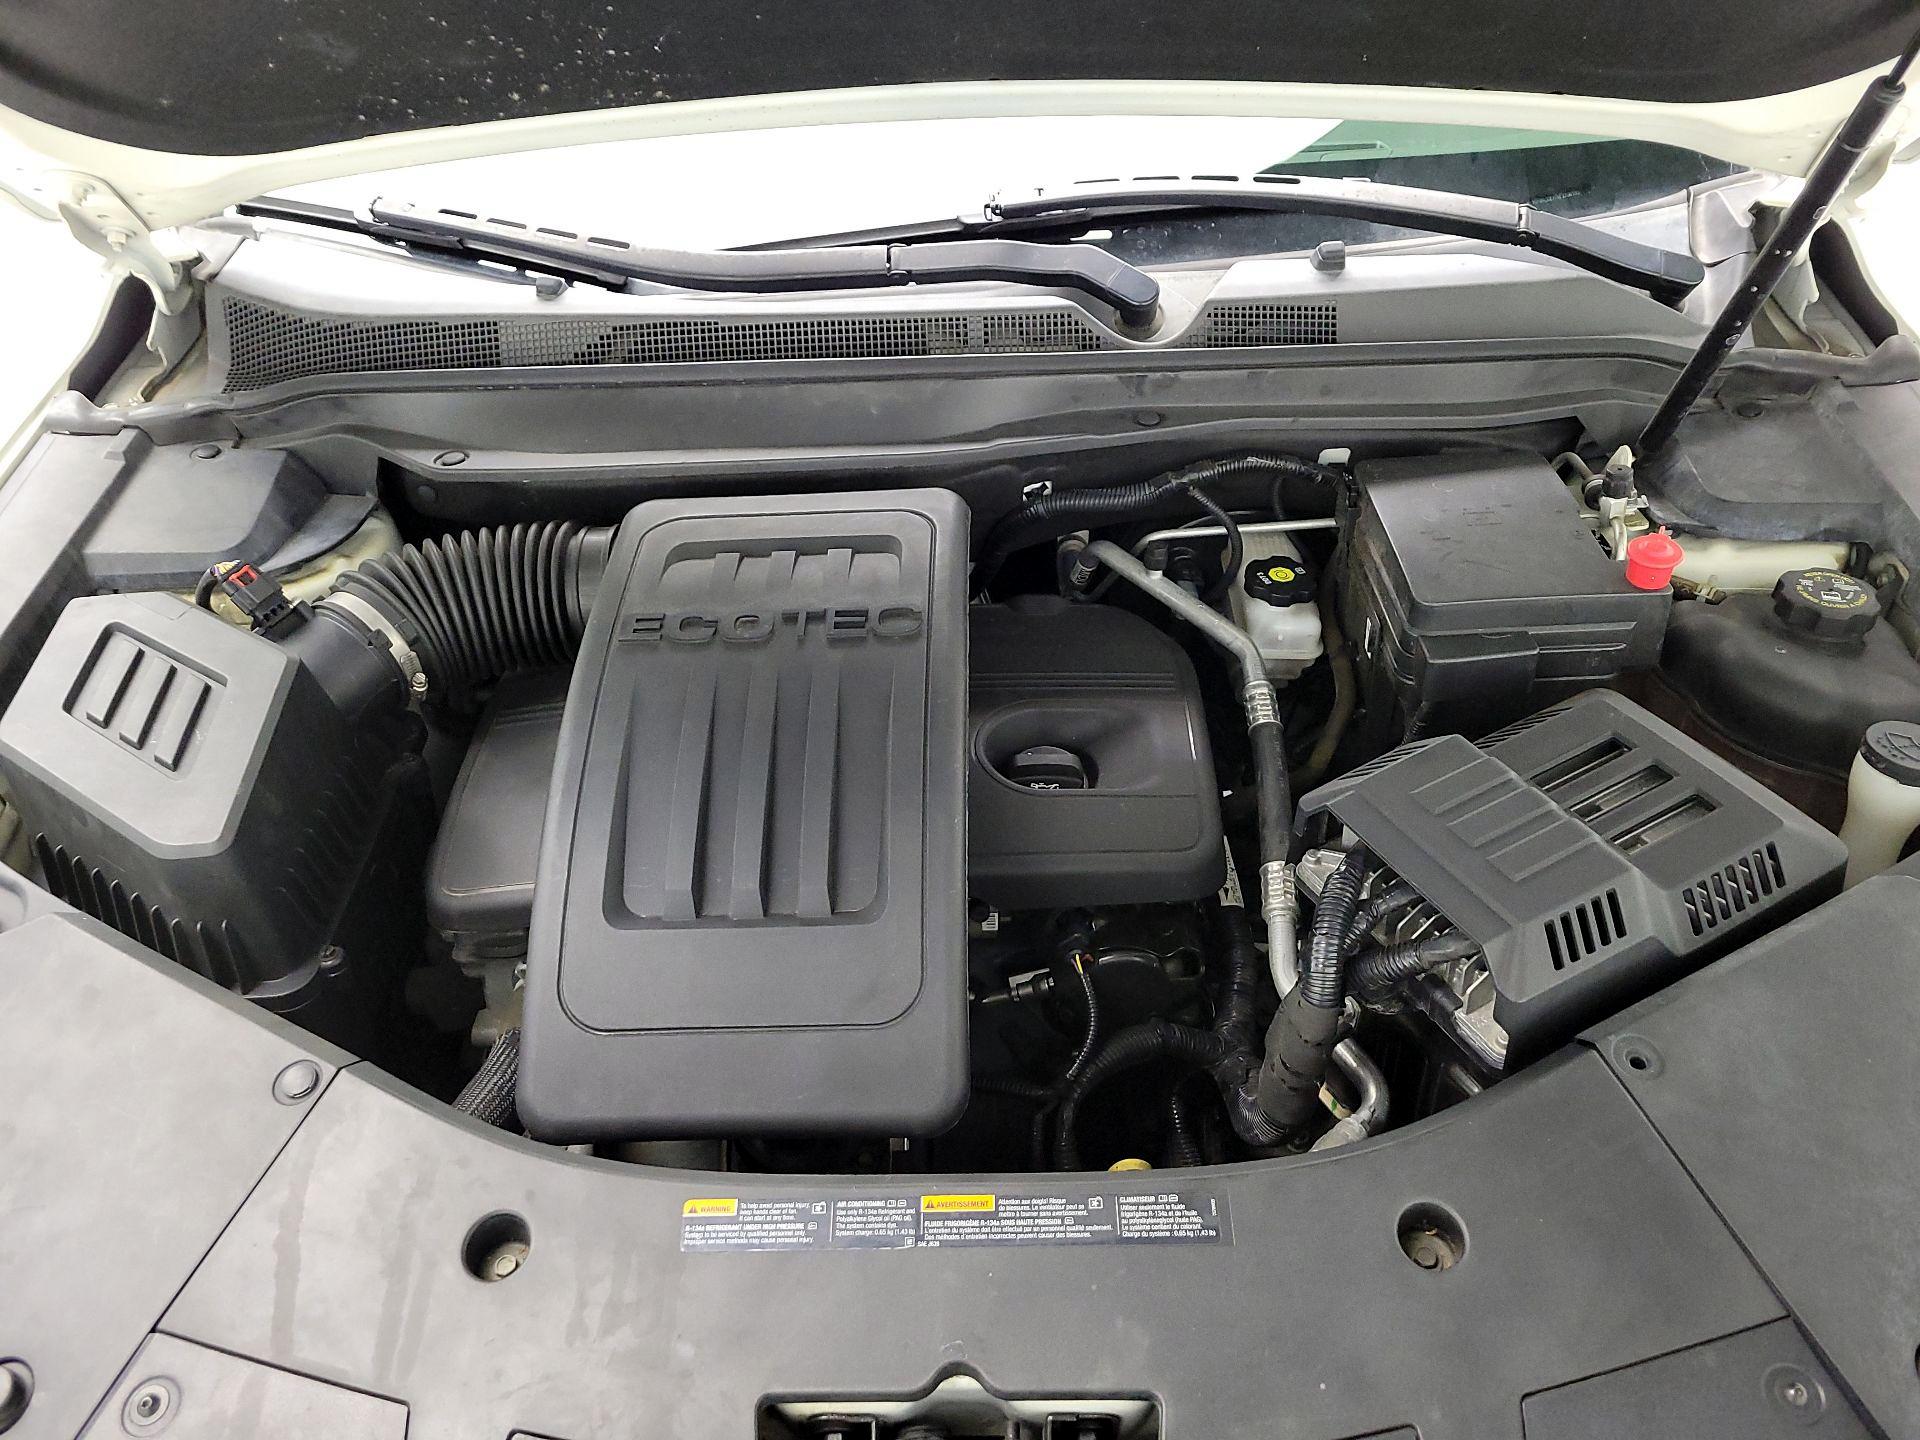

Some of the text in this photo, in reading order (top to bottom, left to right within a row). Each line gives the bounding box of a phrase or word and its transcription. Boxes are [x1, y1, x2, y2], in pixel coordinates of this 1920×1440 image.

[618, 606, 922, 643] ECOTEC
[1049, 1197, 1067, 1205] Risque
[1120, 1195, 1156, 1203] CLIMATISEUR
[748, 1202, 758, 1210] help
[774, 1202, 795, 1210] personal
[837, 1200, 847, 1208] AIR
[937, 1200, 989, 1208] AVERTISSEMENT
[1040, 1203, 1065, 1211] ventilateur
[701, 1205, 732, 1213] WARNING
[945, 1218, 980, 1227] FRIGORIGÈNE
[1016, 1218, 1034, 1226] HAUTE
[960, 1226, 980, 1235] système
[1041, 1225, 1066, 1233] personnel
[1129, 1223, 1151, 1232] système
[740, 1231, 747, 1239] by
[748, 1230, 768, 1238] qualified
[769, 1230, 794, 1238] personnel
[836, 1229, 854, 1237] System
[1122, 1231, 1141, 1239] Charge
[1149, 1230, 1170, 1238] système
[1187, 1230, 1194, 1238] kg
